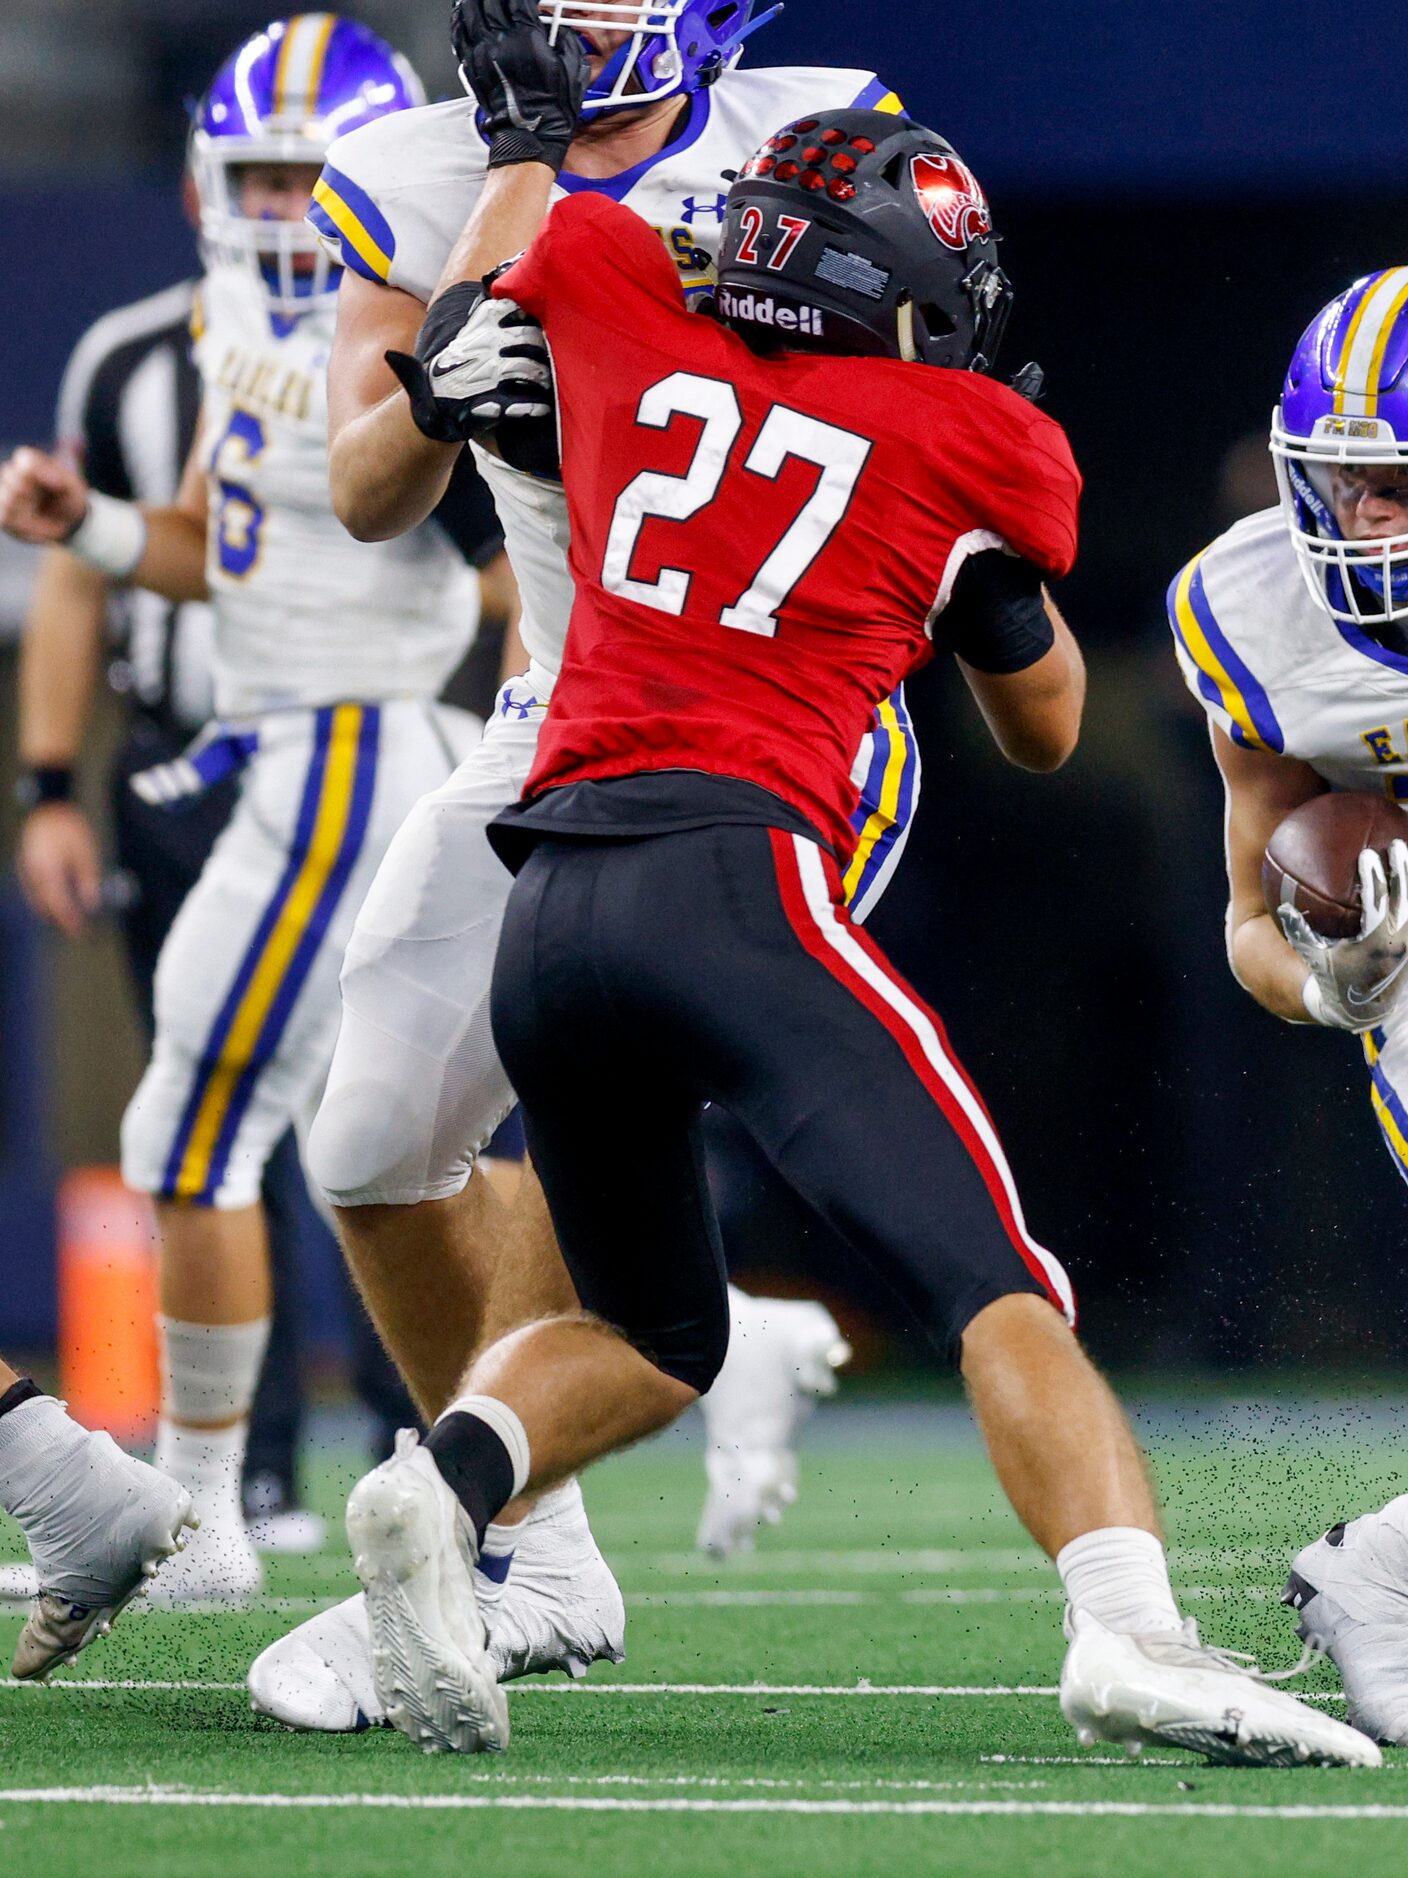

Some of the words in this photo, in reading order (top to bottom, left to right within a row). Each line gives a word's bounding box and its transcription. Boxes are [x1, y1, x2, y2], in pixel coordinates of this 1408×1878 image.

[735, 206, 811, 271] 27
[718, 289, 824, 336] Riddell
[208, 398, 270, 580] 6
[600, 369, 876, 638] 27
